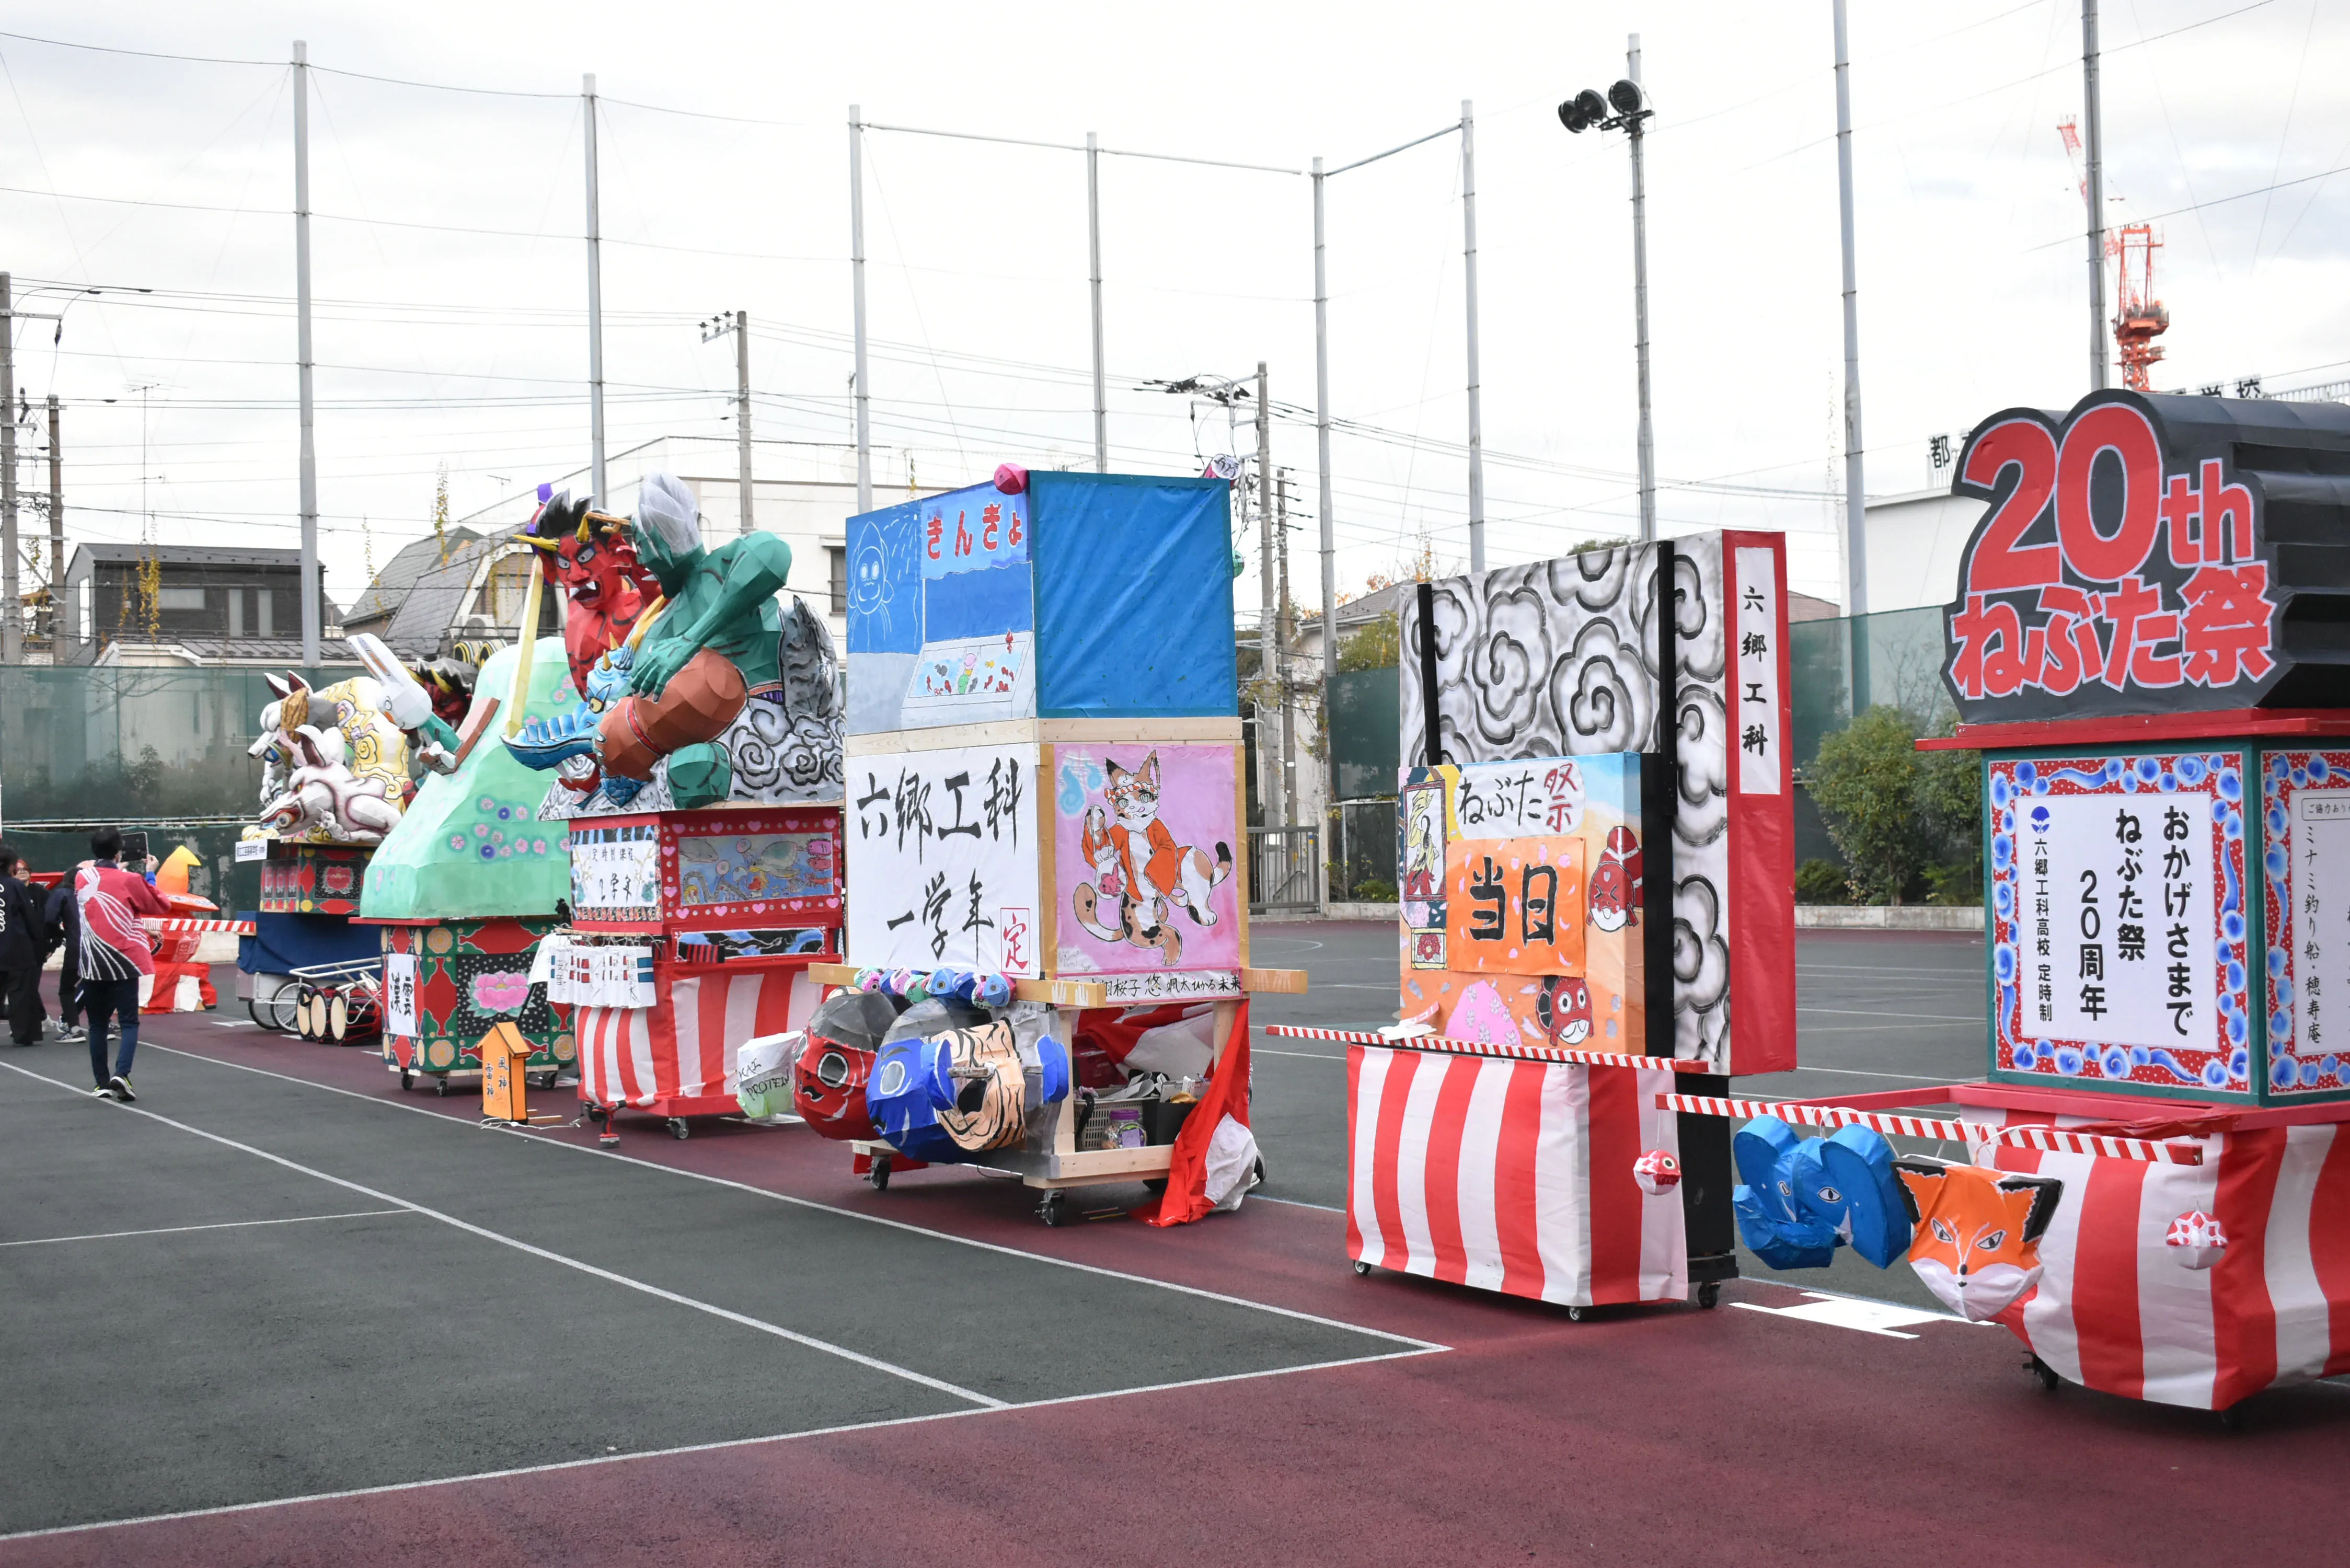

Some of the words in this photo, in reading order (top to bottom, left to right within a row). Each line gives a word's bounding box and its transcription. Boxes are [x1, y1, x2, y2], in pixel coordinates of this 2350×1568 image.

[927, 502, 1022, 559] きんぎょ
[1961, 401, 2254, 594] 20th
[1741, 585, 1768, 757] 六郷工科
[1949, 560, 2277, 700] ねぶた祭
[857, 757, 1022, 864] 六郷工科
[1459, 763, 1579, 833] ねぶた祭
[2308, 803, 2350, 813] ご協力あり
[887, 868, 995, 969] 一学年
[1469, 856, 1558, 948] 当日
[2034, 838, 2051, 956] 六郷工科高校
[2115, 809, 2146, 961] ねぶた祭
[2163, 805, 2193, 1036] おかげさまで
[1003, 912, 1028, 969] 定
[2078, 870, 2107, 1021] 20周年
[2038, 964, 2052, 1022] 定時制
[498, 1057, 509, 1091] 風神
[745, 1068, 790, 1101] PROTEIN
